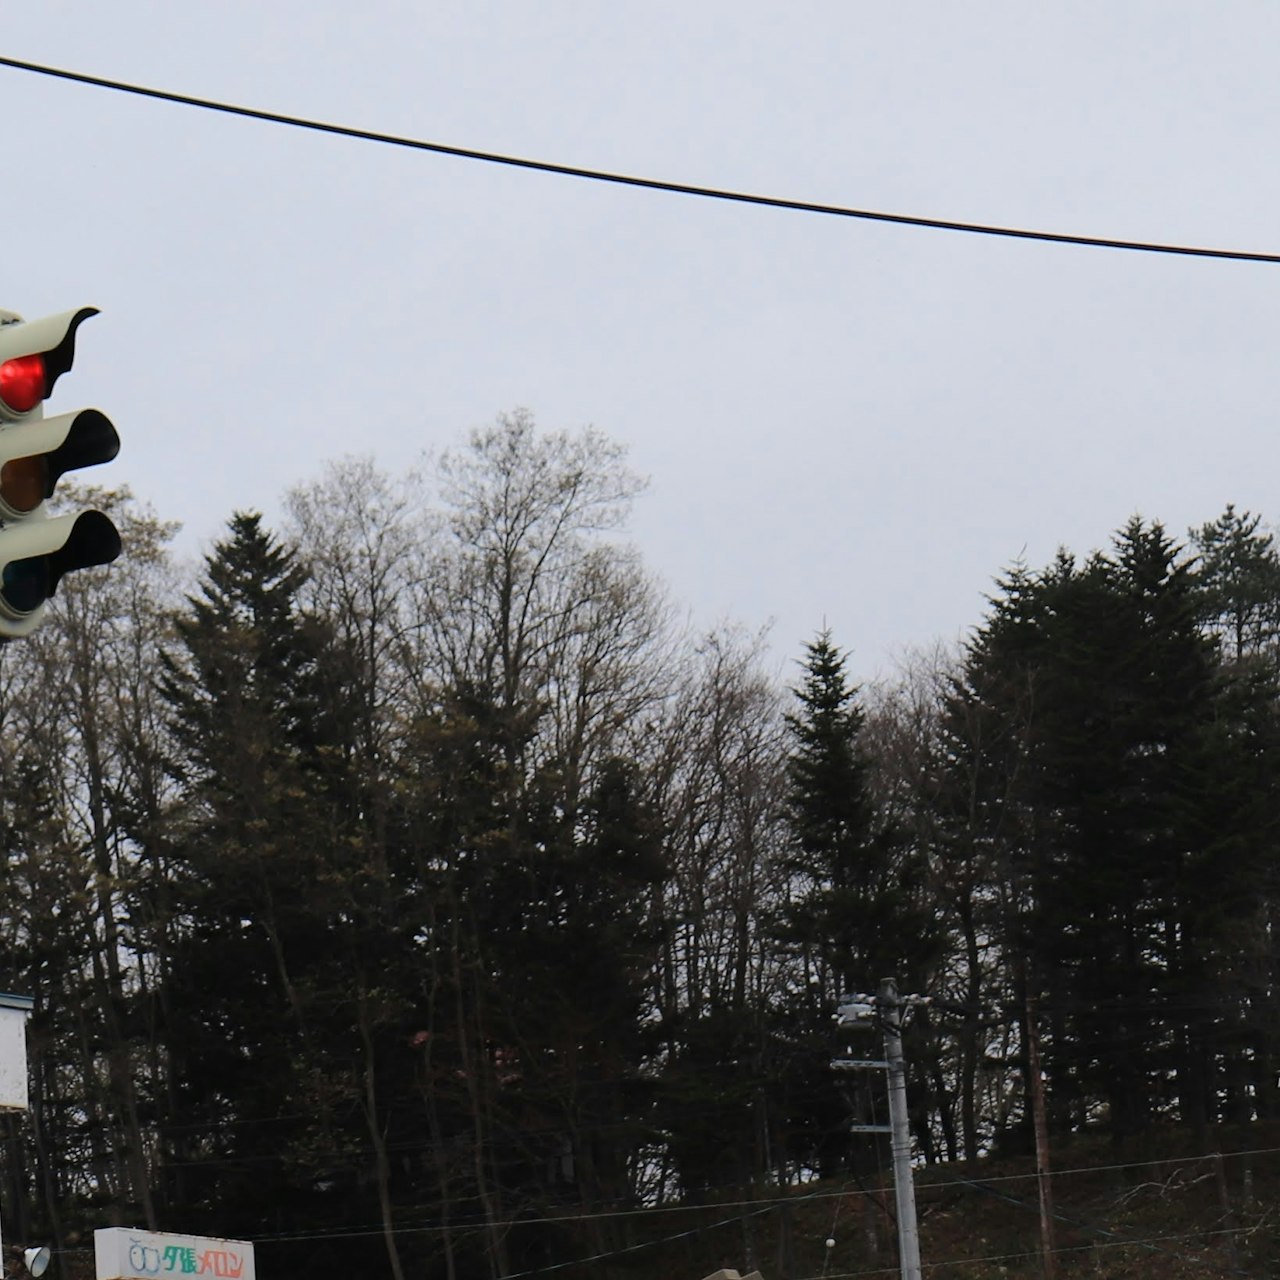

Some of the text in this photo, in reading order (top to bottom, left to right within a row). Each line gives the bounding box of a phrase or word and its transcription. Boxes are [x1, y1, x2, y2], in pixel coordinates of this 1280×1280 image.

[162, 1245, 244, 1279] 夕張メロン
